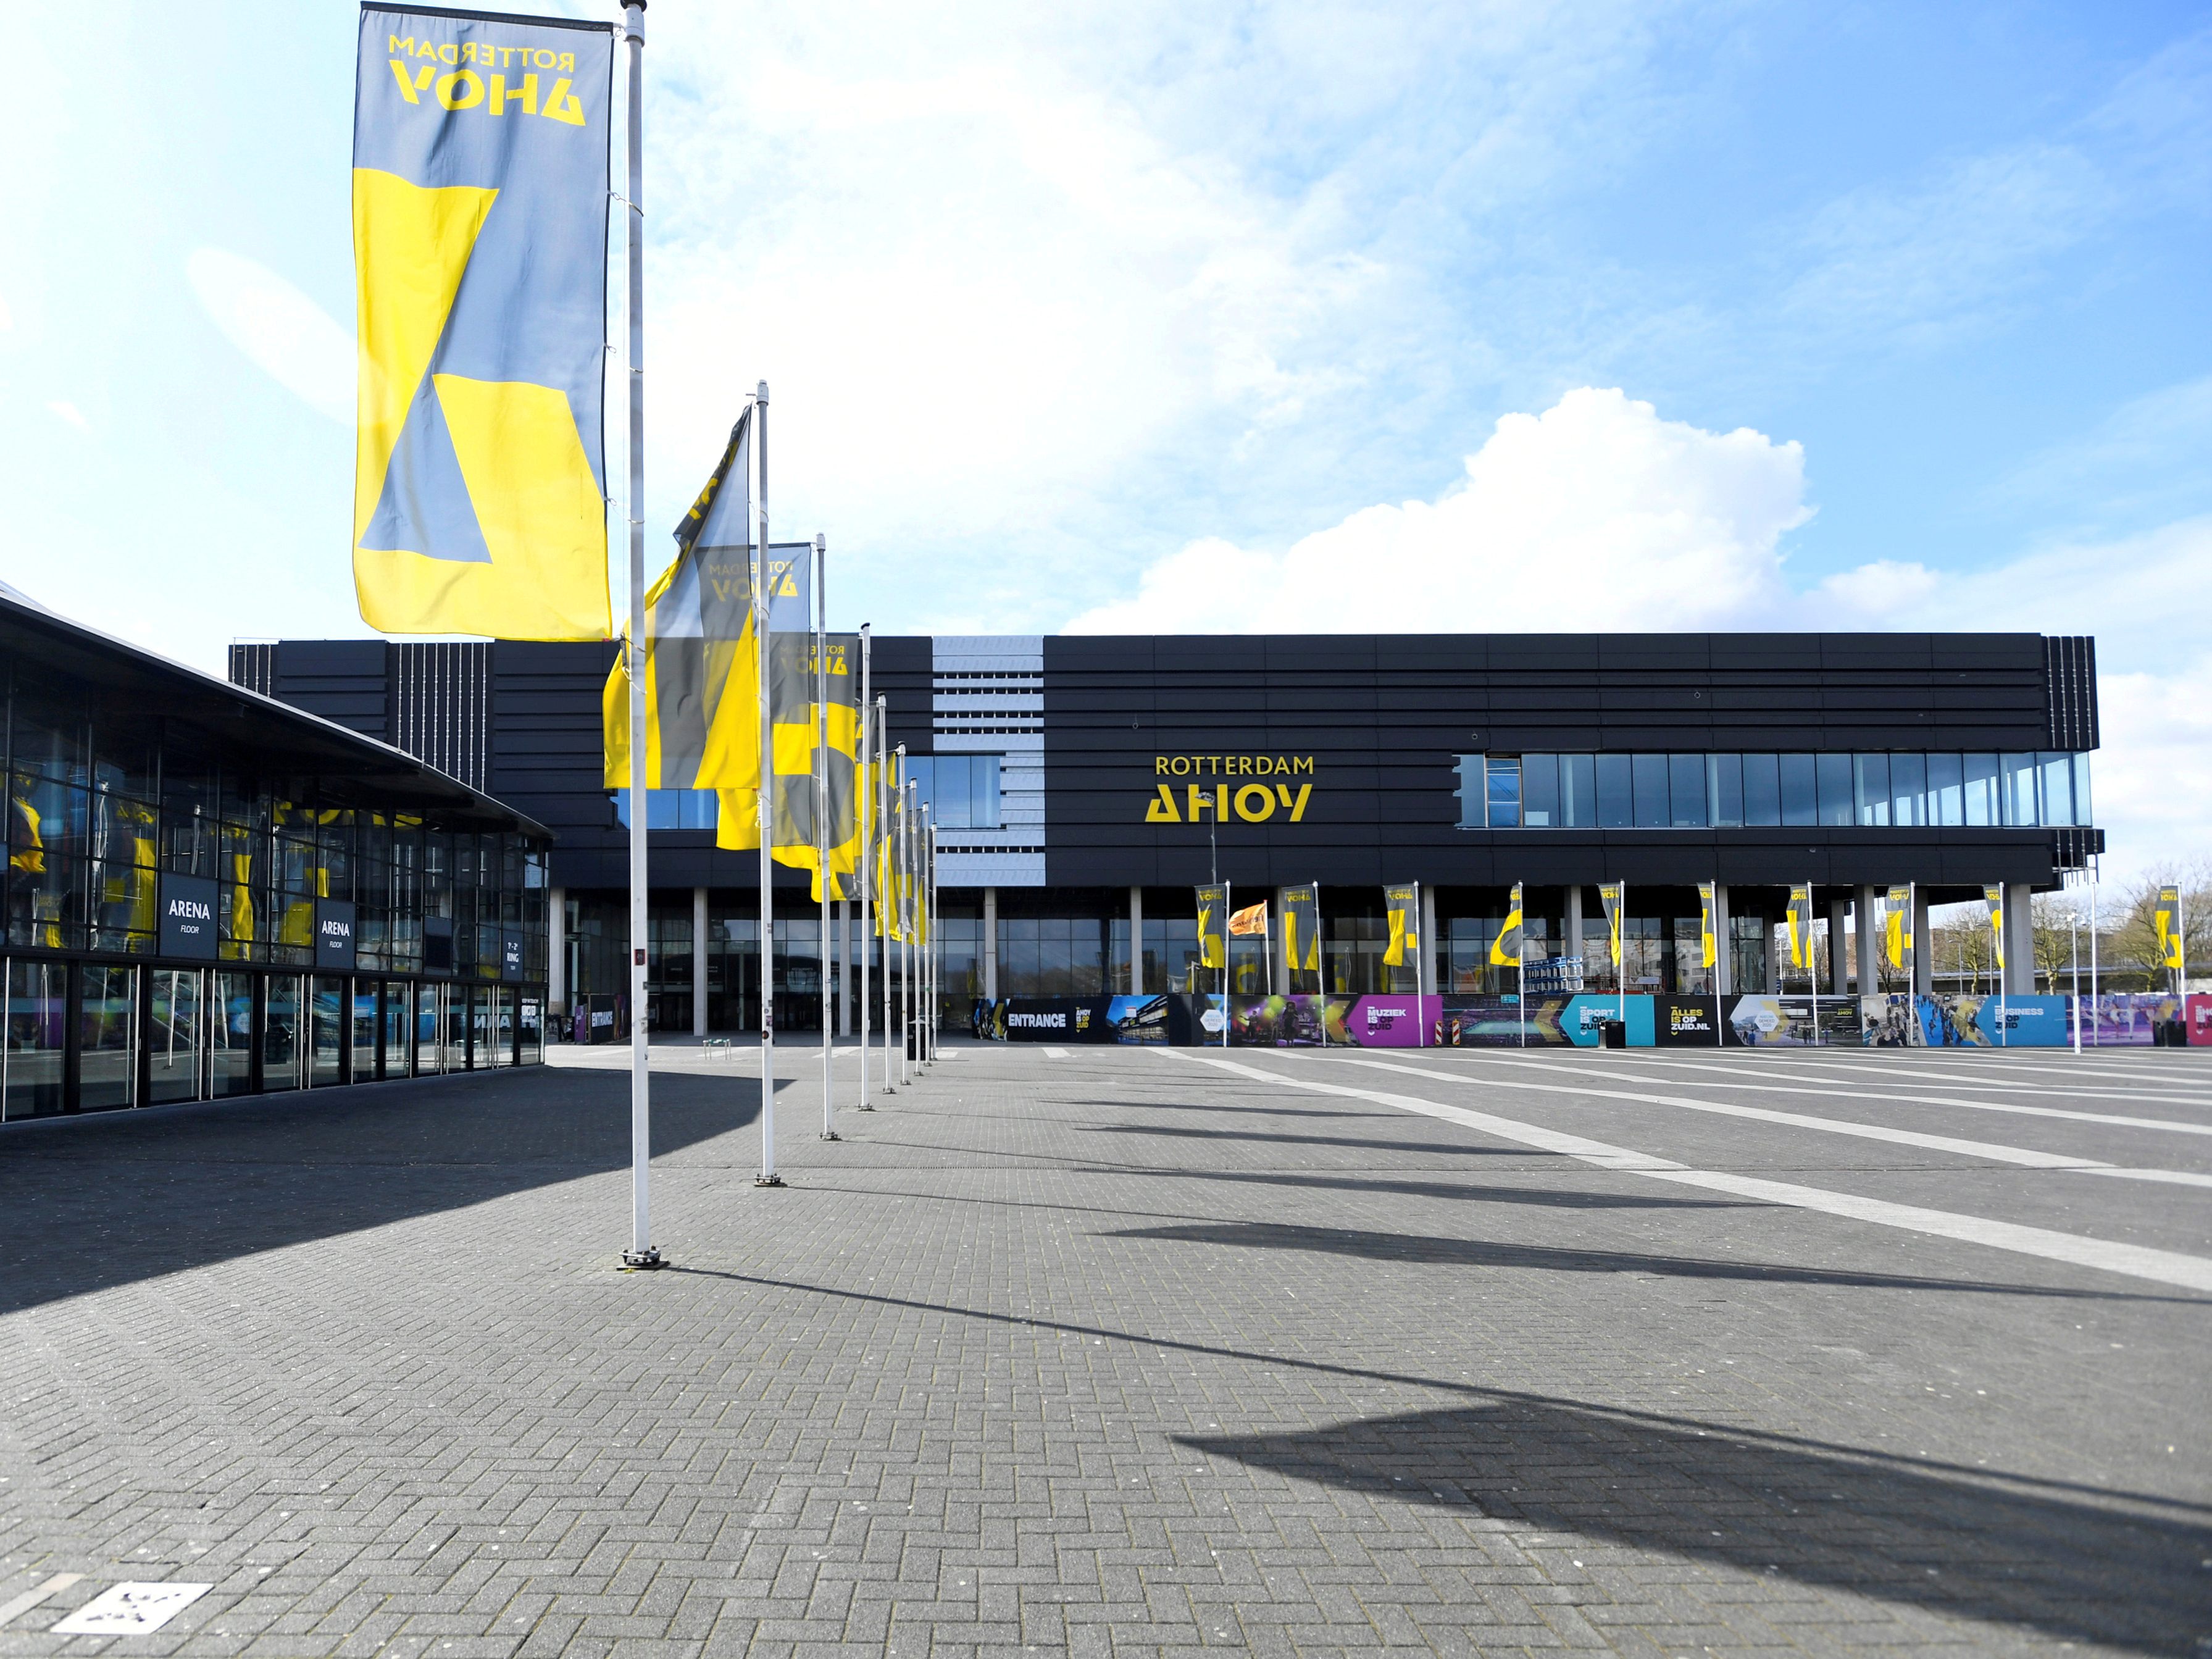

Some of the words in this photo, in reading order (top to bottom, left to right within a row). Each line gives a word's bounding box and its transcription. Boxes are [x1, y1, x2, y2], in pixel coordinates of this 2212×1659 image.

[1156, 756, 1313, 775] ROTTERDAM
[1145, 784, 1313, 822] AHOY
[169, 899, 211, 920] ARENA
[180, 925, 199, 934] FLOOR
[322, 920, 350, 937] ARENA
[1008, 1014, 1066, 1027] ENTRANCE
